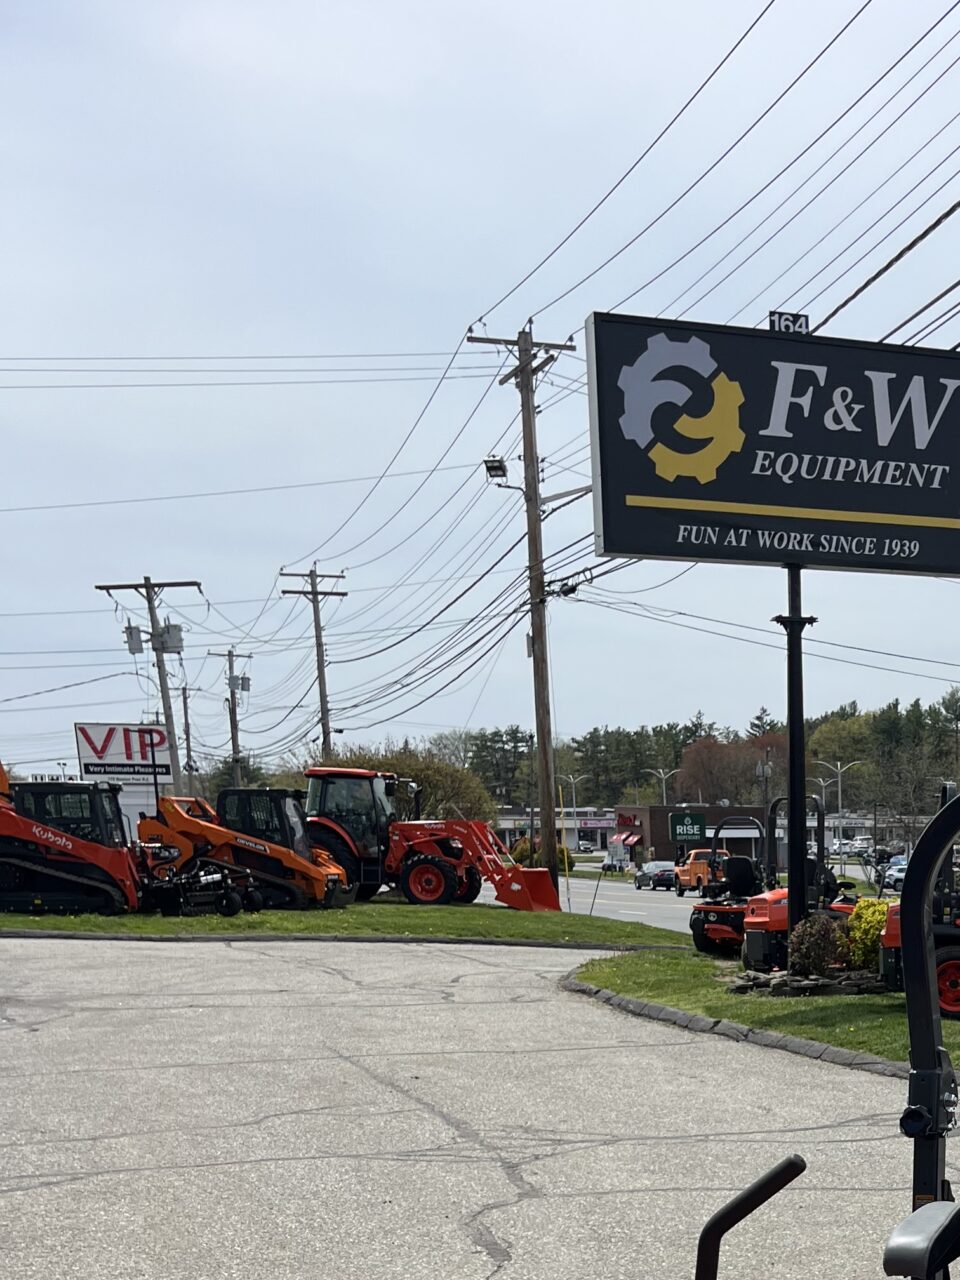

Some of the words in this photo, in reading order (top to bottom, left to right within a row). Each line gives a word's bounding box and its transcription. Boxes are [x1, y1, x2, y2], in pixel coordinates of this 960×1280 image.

[770, 313, 808, 335] 164
[751, 450, 950, 489] EQUIPMENT
[676, 525, 721, 546] FUN
[724, 528, 752, 547] AT
[757, 530, 814, 552] WORK
[819, 535, 877, 556] SINCE
[881, 538, 920, 558] 1939
[77, 726, 167, 761] VIP
[88, 765, 104, 774] Very
[105, 765, 133, 773] Intimate
[134, 765, 166, 773] Pleasres
[32, 825, 72, 850] Kubota
[676, 825, 700, 835] RISE
